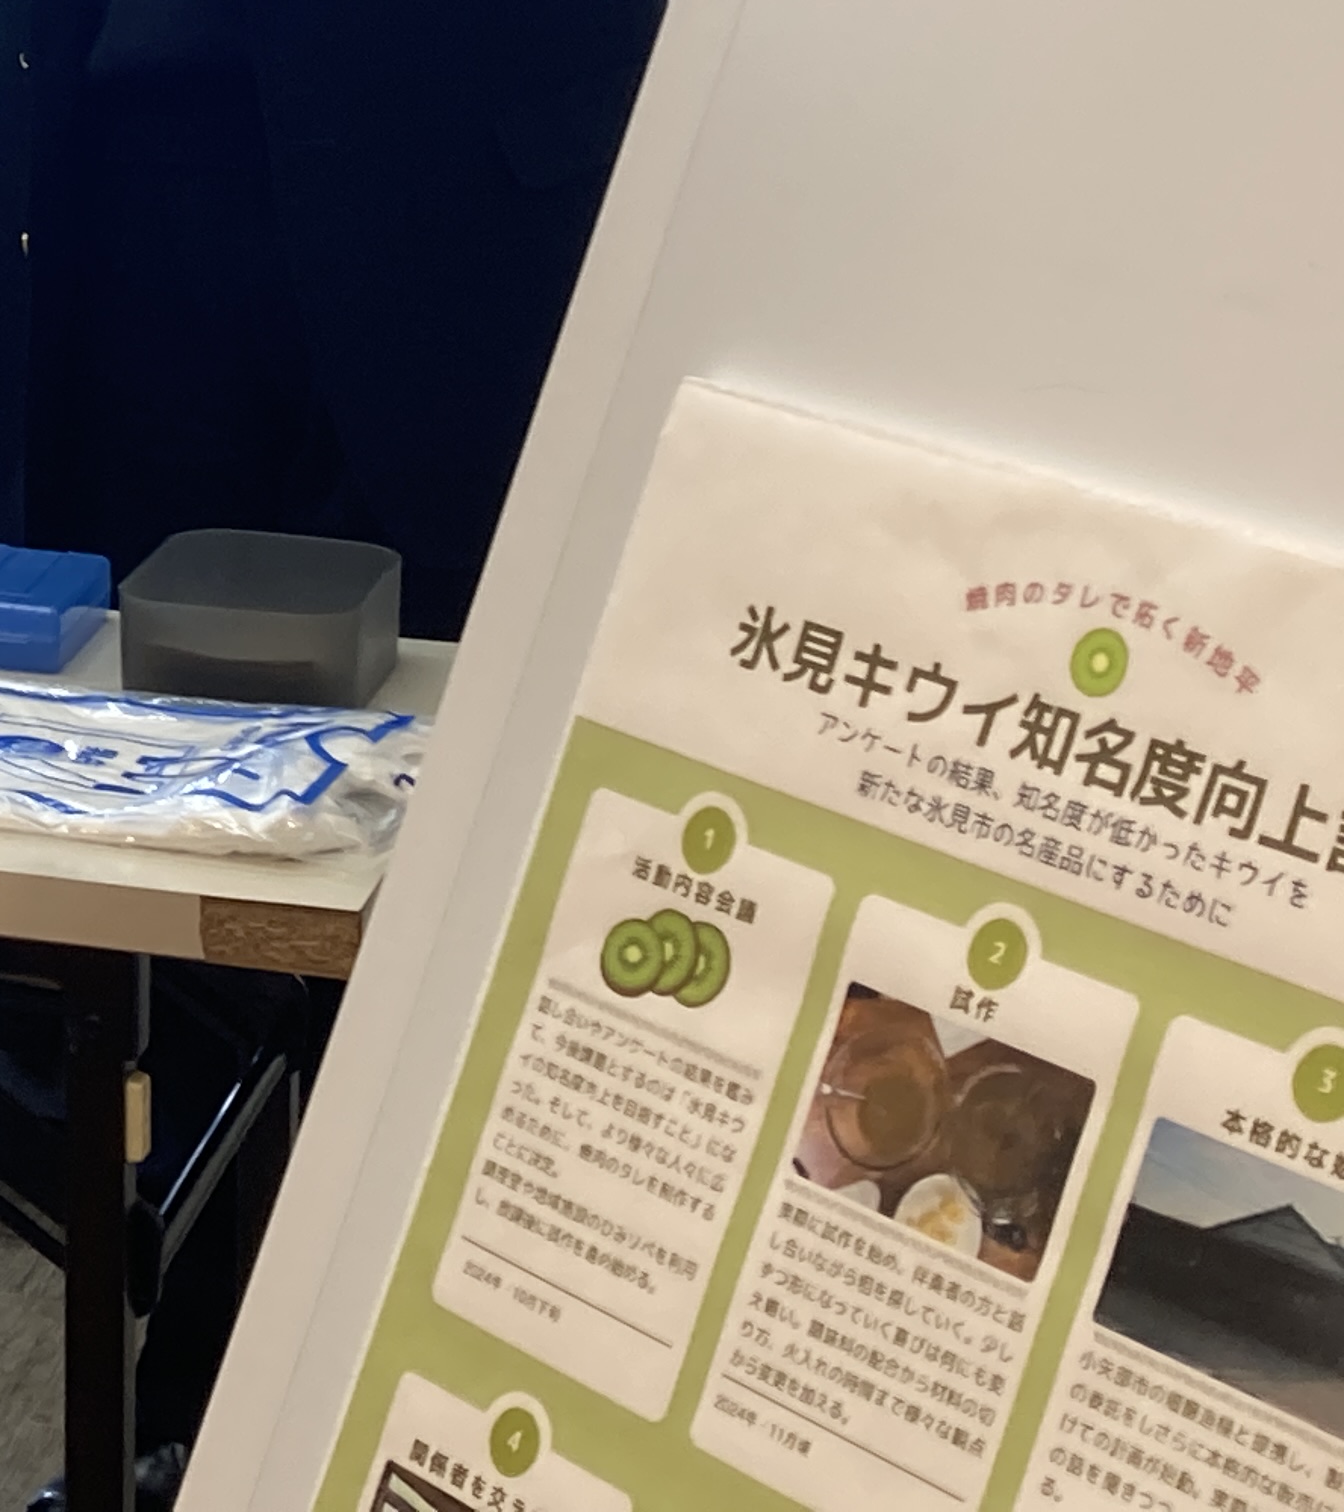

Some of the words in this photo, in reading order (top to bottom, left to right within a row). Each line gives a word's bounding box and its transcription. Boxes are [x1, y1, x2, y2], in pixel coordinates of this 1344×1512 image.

[816, 712, 1310, 910] アンケートの結果、知名度が低かったキウイを
[703, 827, 716, 851] 1
[856, 768, 1234, 928] 新たな氷見市の名産品にするために
[989, 941, 1006, 966] 2
[949, 984, 1000, 1023] 試作
[1317, 1066, 1337, 1094] 3
[506, 1429, 524, 1454] 4
